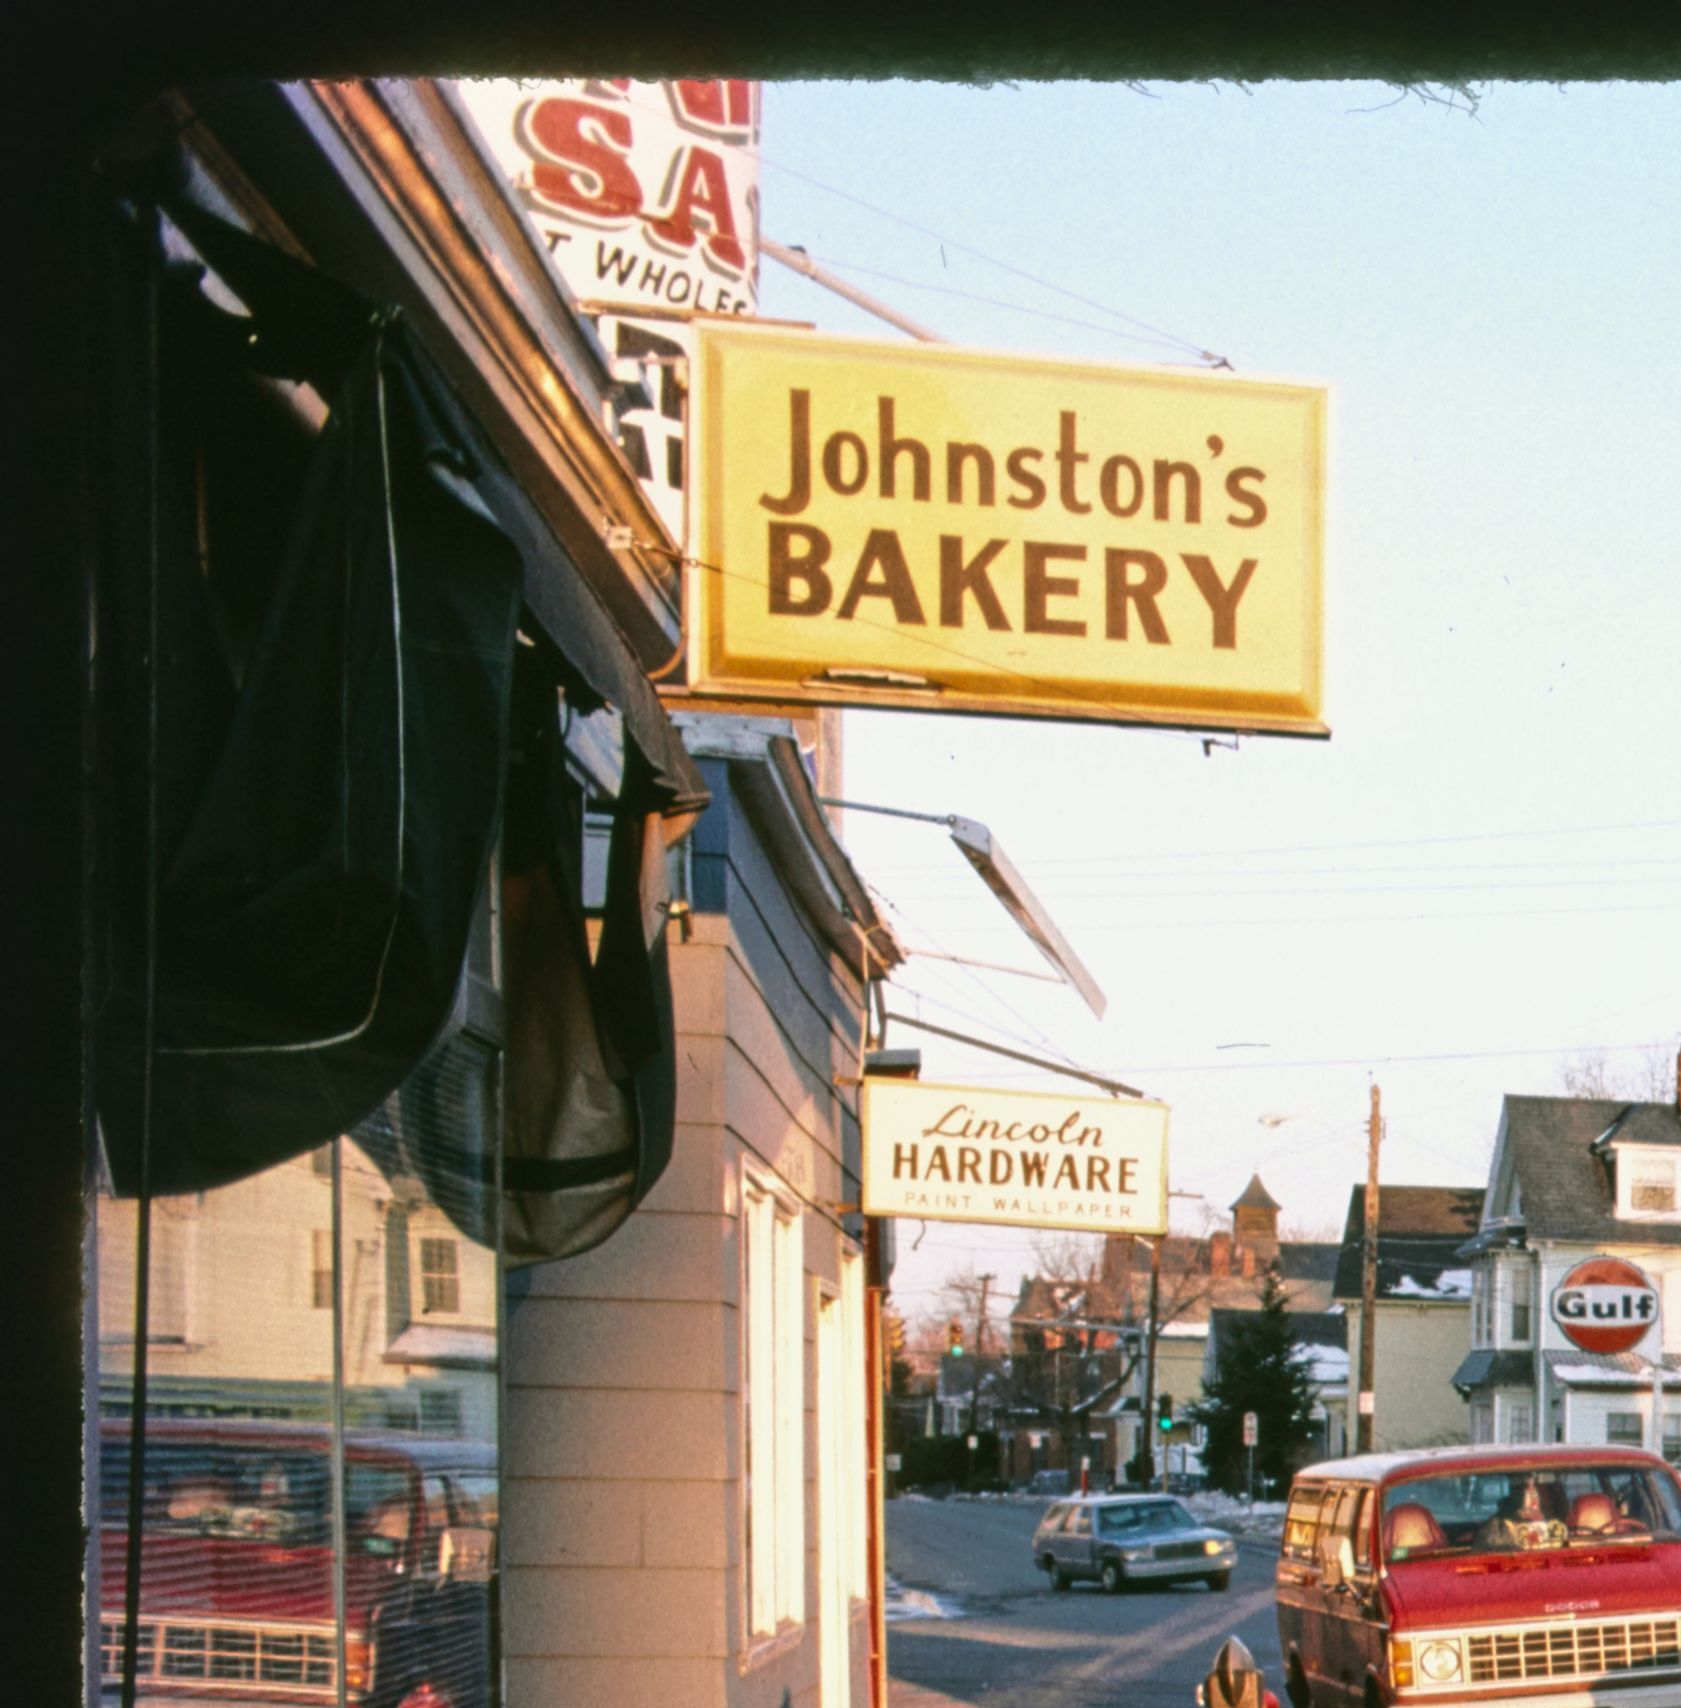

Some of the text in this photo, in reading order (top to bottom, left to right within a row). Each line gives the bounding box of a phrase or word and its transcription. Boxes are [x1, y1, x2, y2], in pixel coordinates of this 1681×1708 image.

[758, 387, 1268, 529] Johnston's
[765, 521, 1259, 650] BAKERY
[922, 1103, 1103, 1148] Lincoln
[892, 1142, 1139, 1195] HARDWARE
[905, 1190, 1132, 1219] PAINT WALLPAPER
[1556, 1290, 1655, 1319] Gulf
